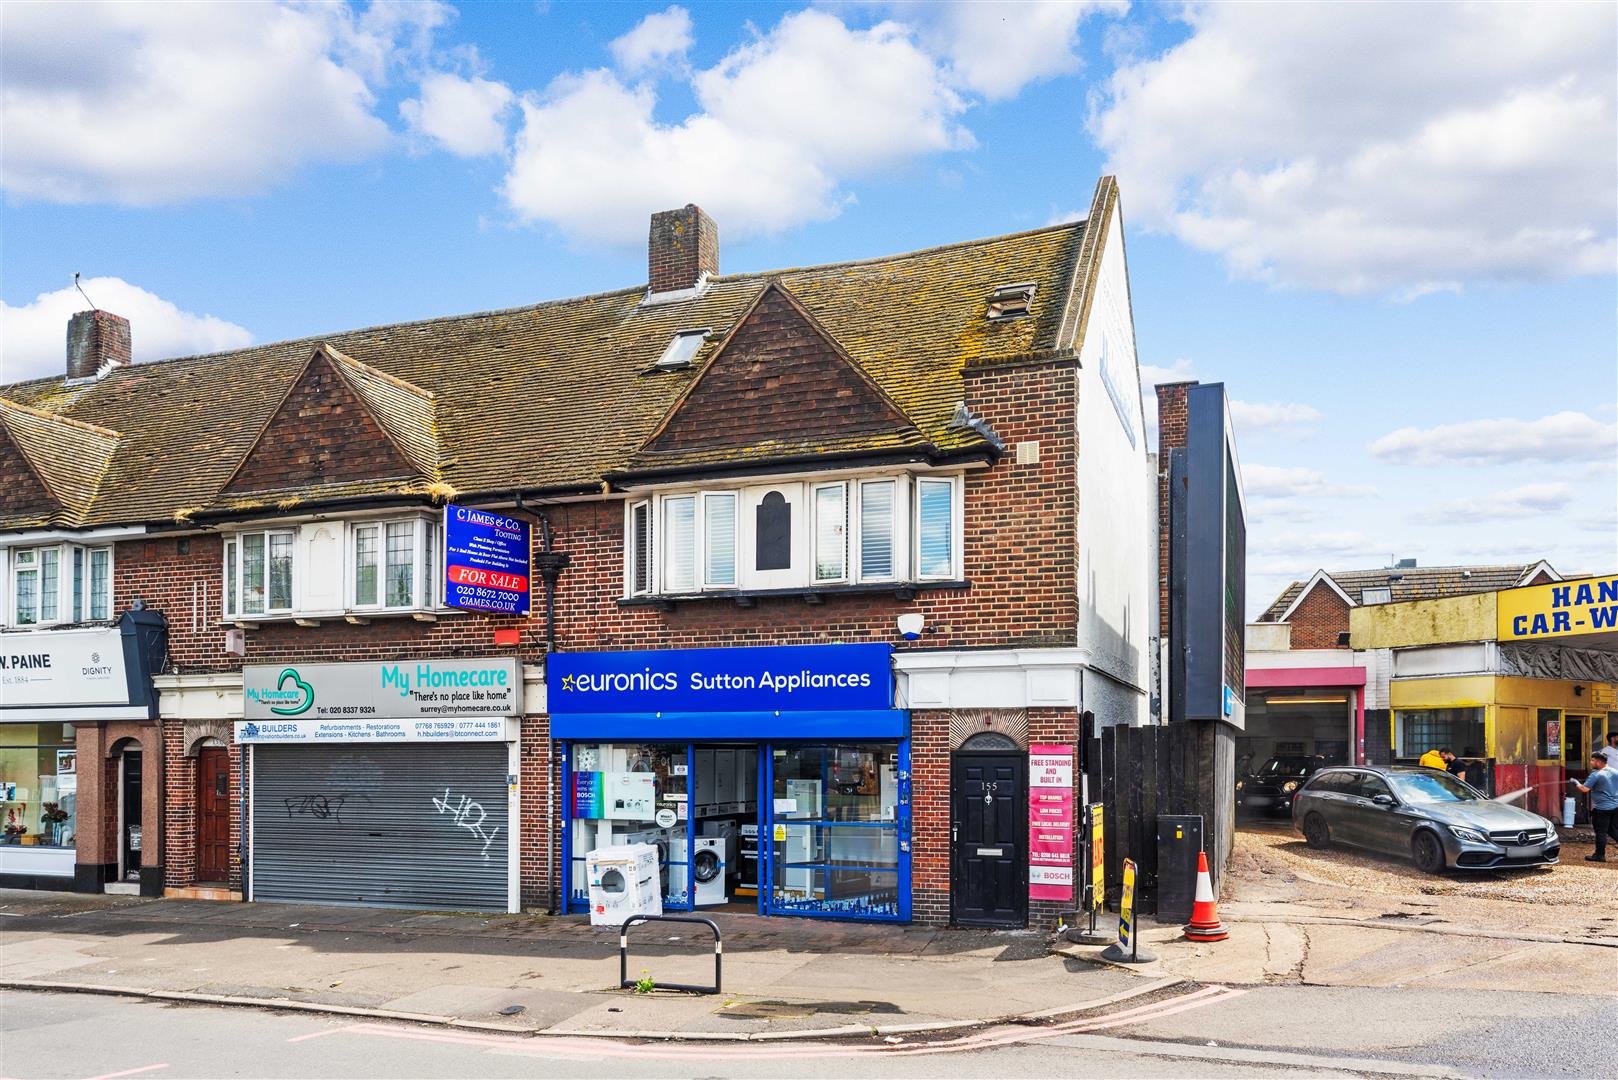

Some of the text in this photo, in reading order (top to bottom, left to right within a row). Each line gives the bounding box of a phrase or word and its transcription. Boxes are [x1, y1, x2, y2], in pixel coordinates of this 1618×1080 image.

[457, 508, 465, 519] C
[467, 510, 494, 525] JAMES
[496, 518, 504, 526] &
[495, 529, 522, 541] TOOTING
[458, 568, 520, 588] FOR SALE
[456, 586, 519, 602] 020 8672 7000
[1552, 580, 1618, 608] HAN
[460, 596, 516, 610] CJAMES.CO.UK
[1514, 606, 1618, 636] CAR-W
[11, 654, 51, 669] PAINE
[82, 666, 112, 675] DIGNITY
[381, 664, 507, 696] My Homecare
[576, 668, 870, 693] euronics Sutton Appliances
[247, 688, 299, 703] My Homecare
[440, 692, 449, 700] no
[452, 691, 470, 703] place
[472, 690, 484, 700] like
[420, 704, 511, 714] surrey@myhomecare.co.uk
[262, 724, 298, 732] BUILDERS
[982, 782, 997, 790] 155
